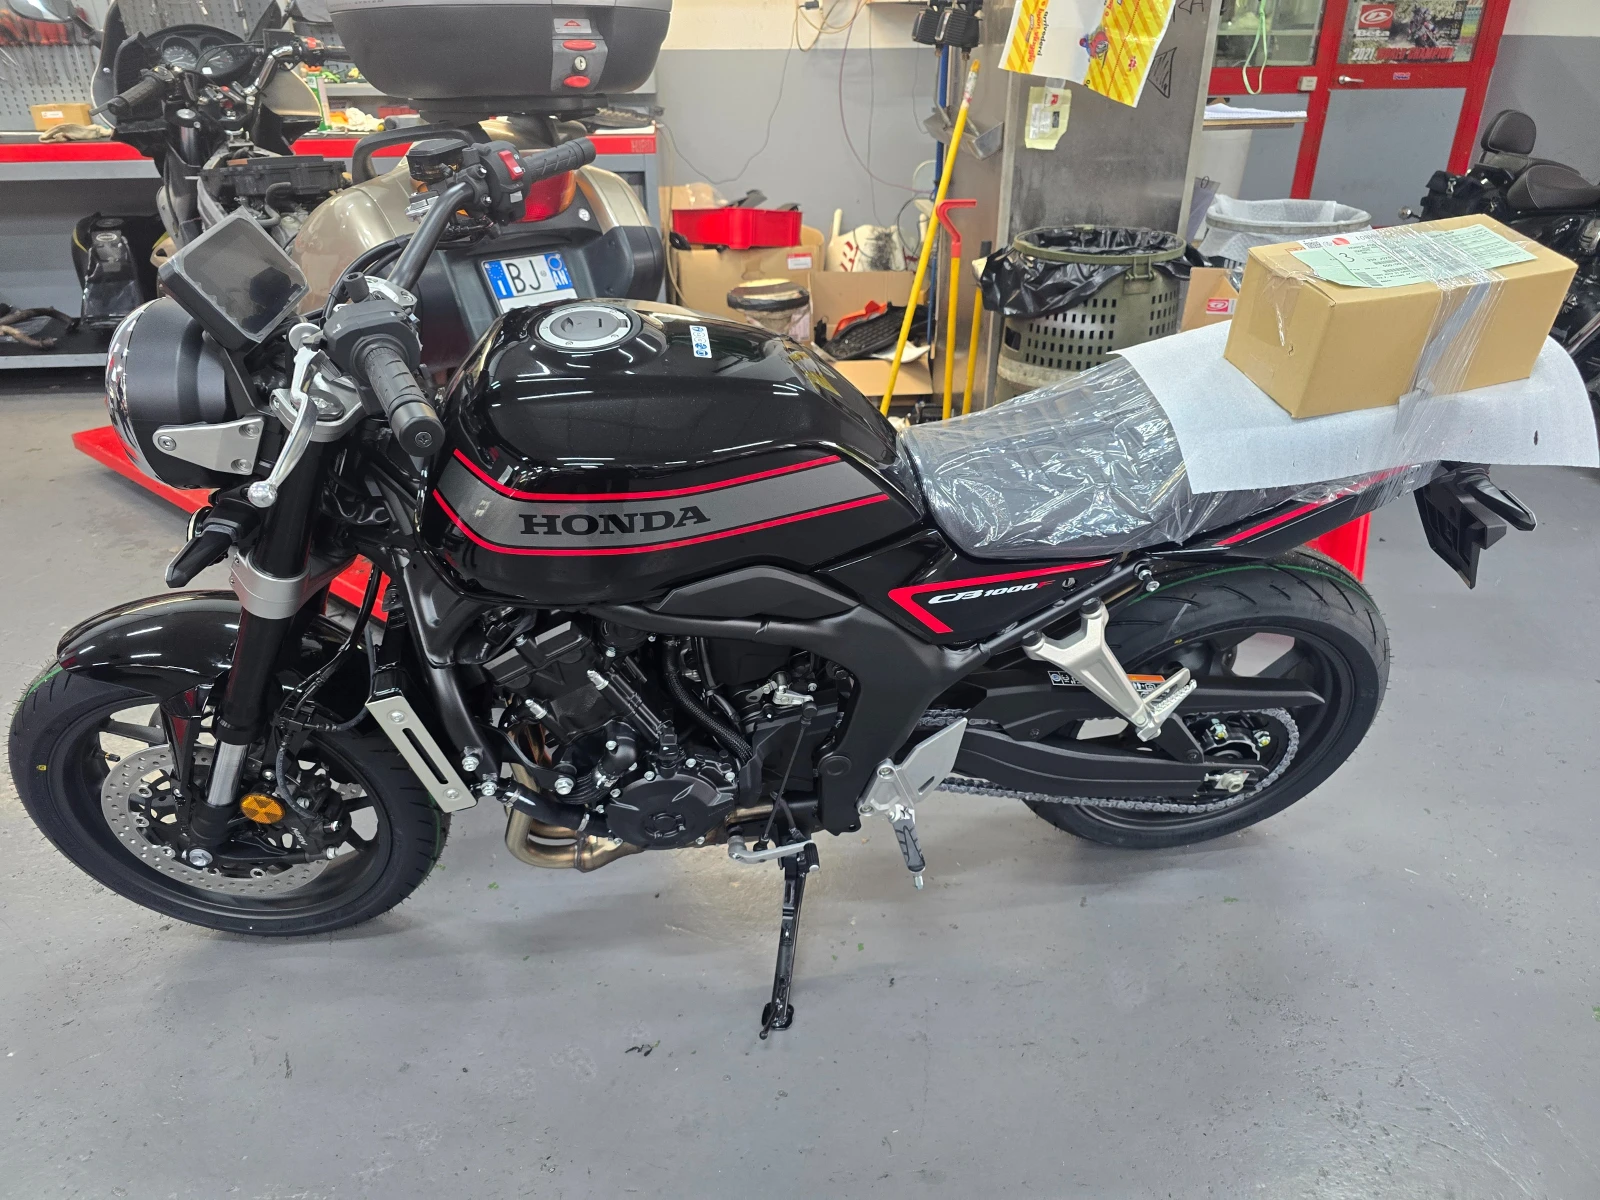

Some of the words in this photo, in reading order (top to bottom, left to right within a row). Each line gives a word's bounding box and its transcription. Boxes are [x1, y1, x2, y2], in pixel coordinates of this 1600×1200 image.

[1036, 8, 1045, 29] buon
[1037, 11, 1049, 56] arrivederci
[1028, 31, 1040, 62] viaggio
[1352, 47, 1375, 60] 2021
[505, 260, 541, 294] BJ
[518, 505, 711, 535] HONDA
[928, 580, 1056, 604] CB1000F
